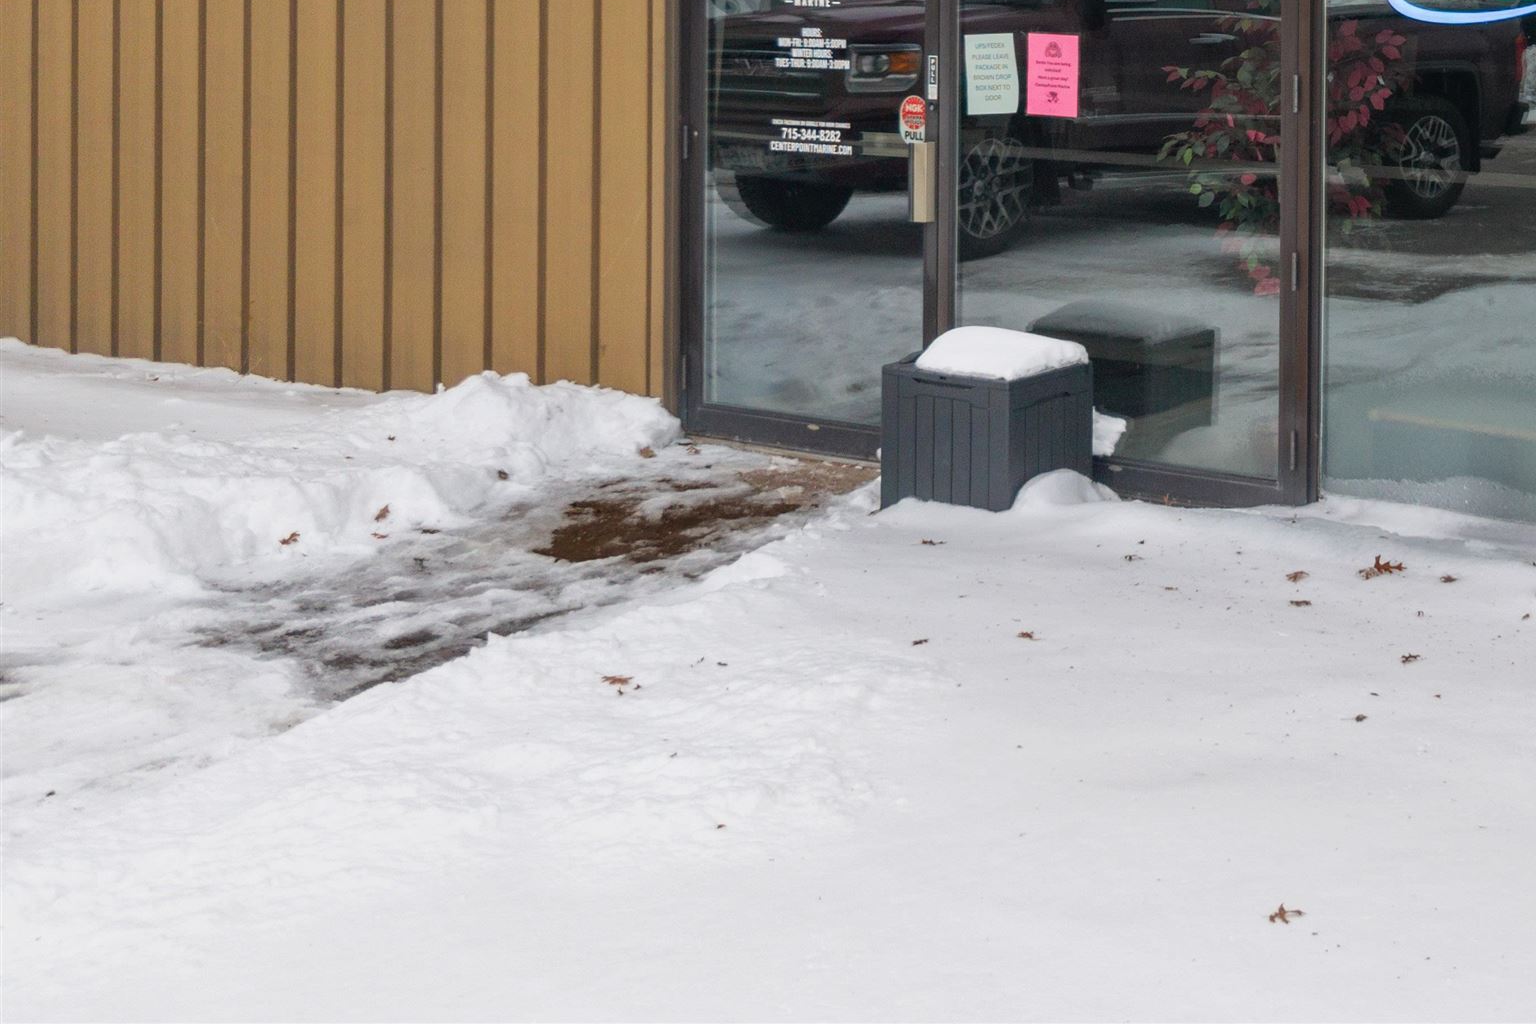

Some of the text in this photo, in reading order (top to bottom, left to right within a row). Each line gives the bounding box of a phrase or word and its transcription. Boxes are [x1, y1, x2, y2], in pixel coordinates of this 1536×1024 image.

[905, 104, 923, 113] NGK
[782, 128, 841, 142] 715-344-8282
[904, 130, 924, 141] PULL
